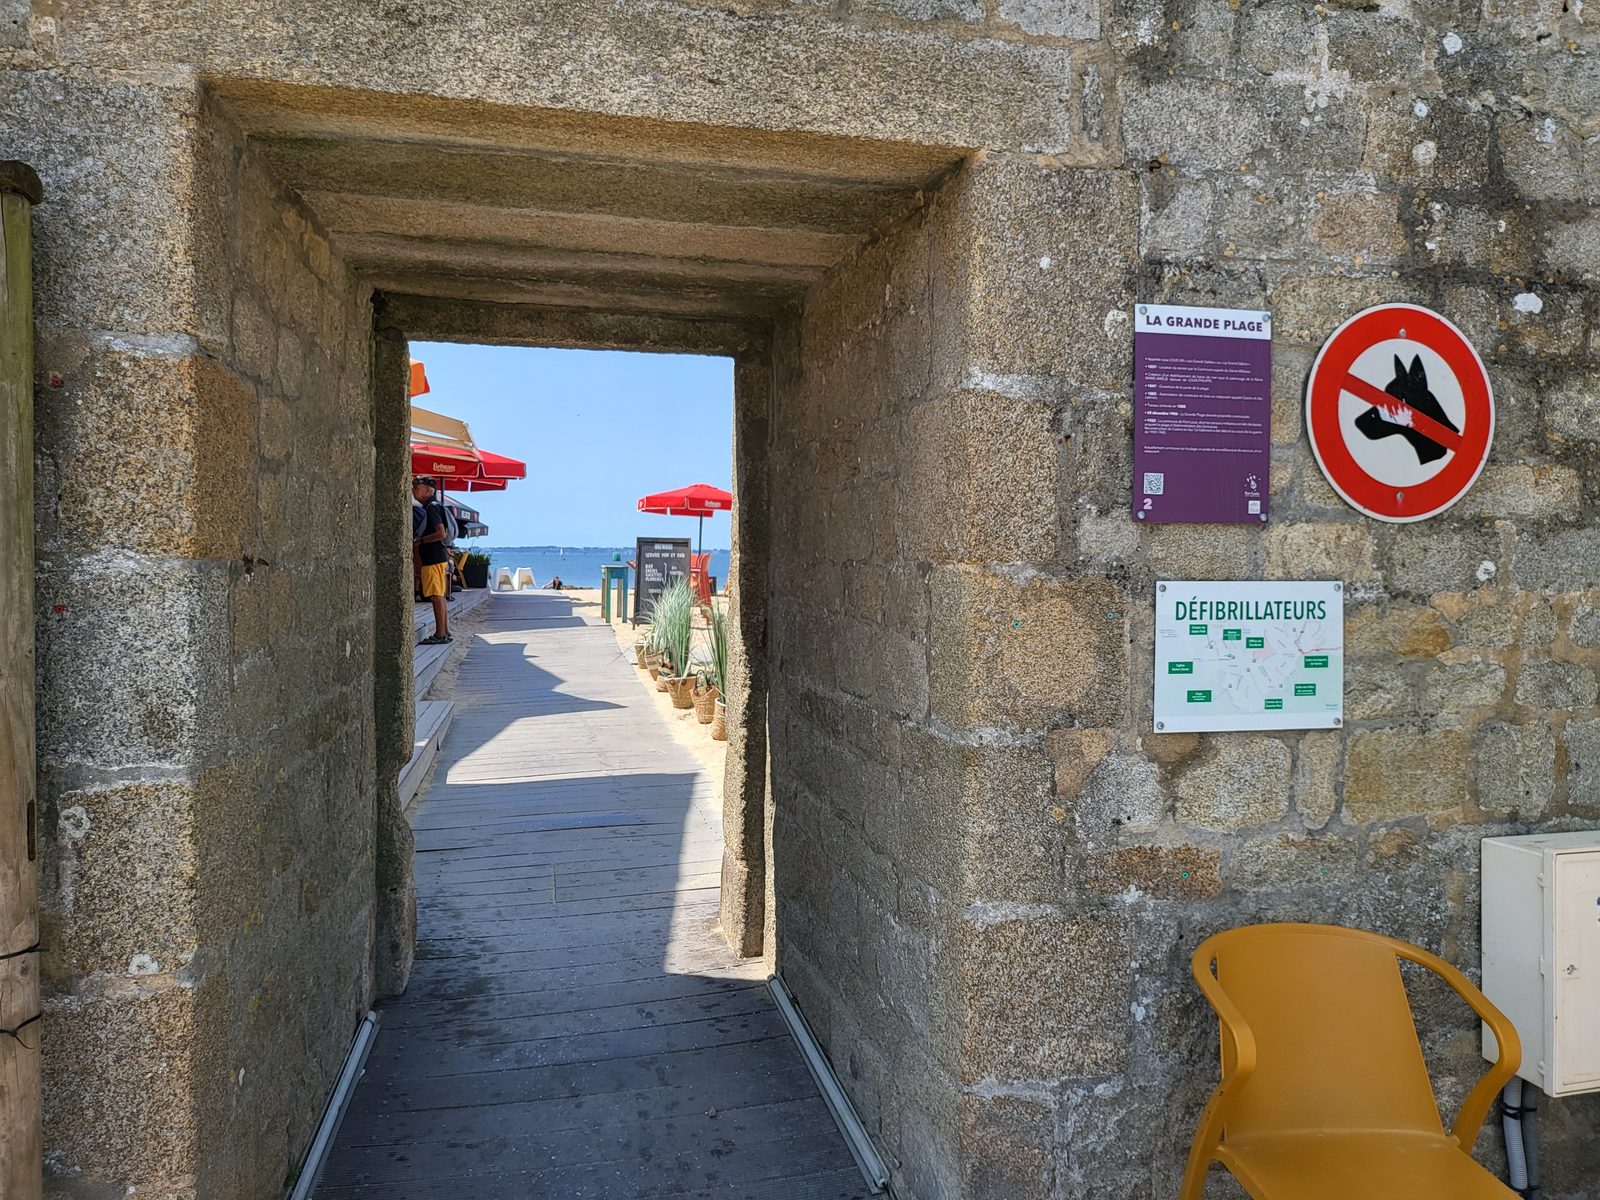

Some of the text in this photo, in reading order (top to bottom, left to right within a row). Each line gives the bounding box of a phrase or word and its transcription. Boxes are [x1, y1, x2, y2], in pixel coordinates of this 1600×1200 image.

[1145, 315, 1263, 332] LA GRANDE PLAGE
[1143, 498, 1153, 510] 2
[1175, 596, 1326, 621] DÉFIBRILLATEURS
